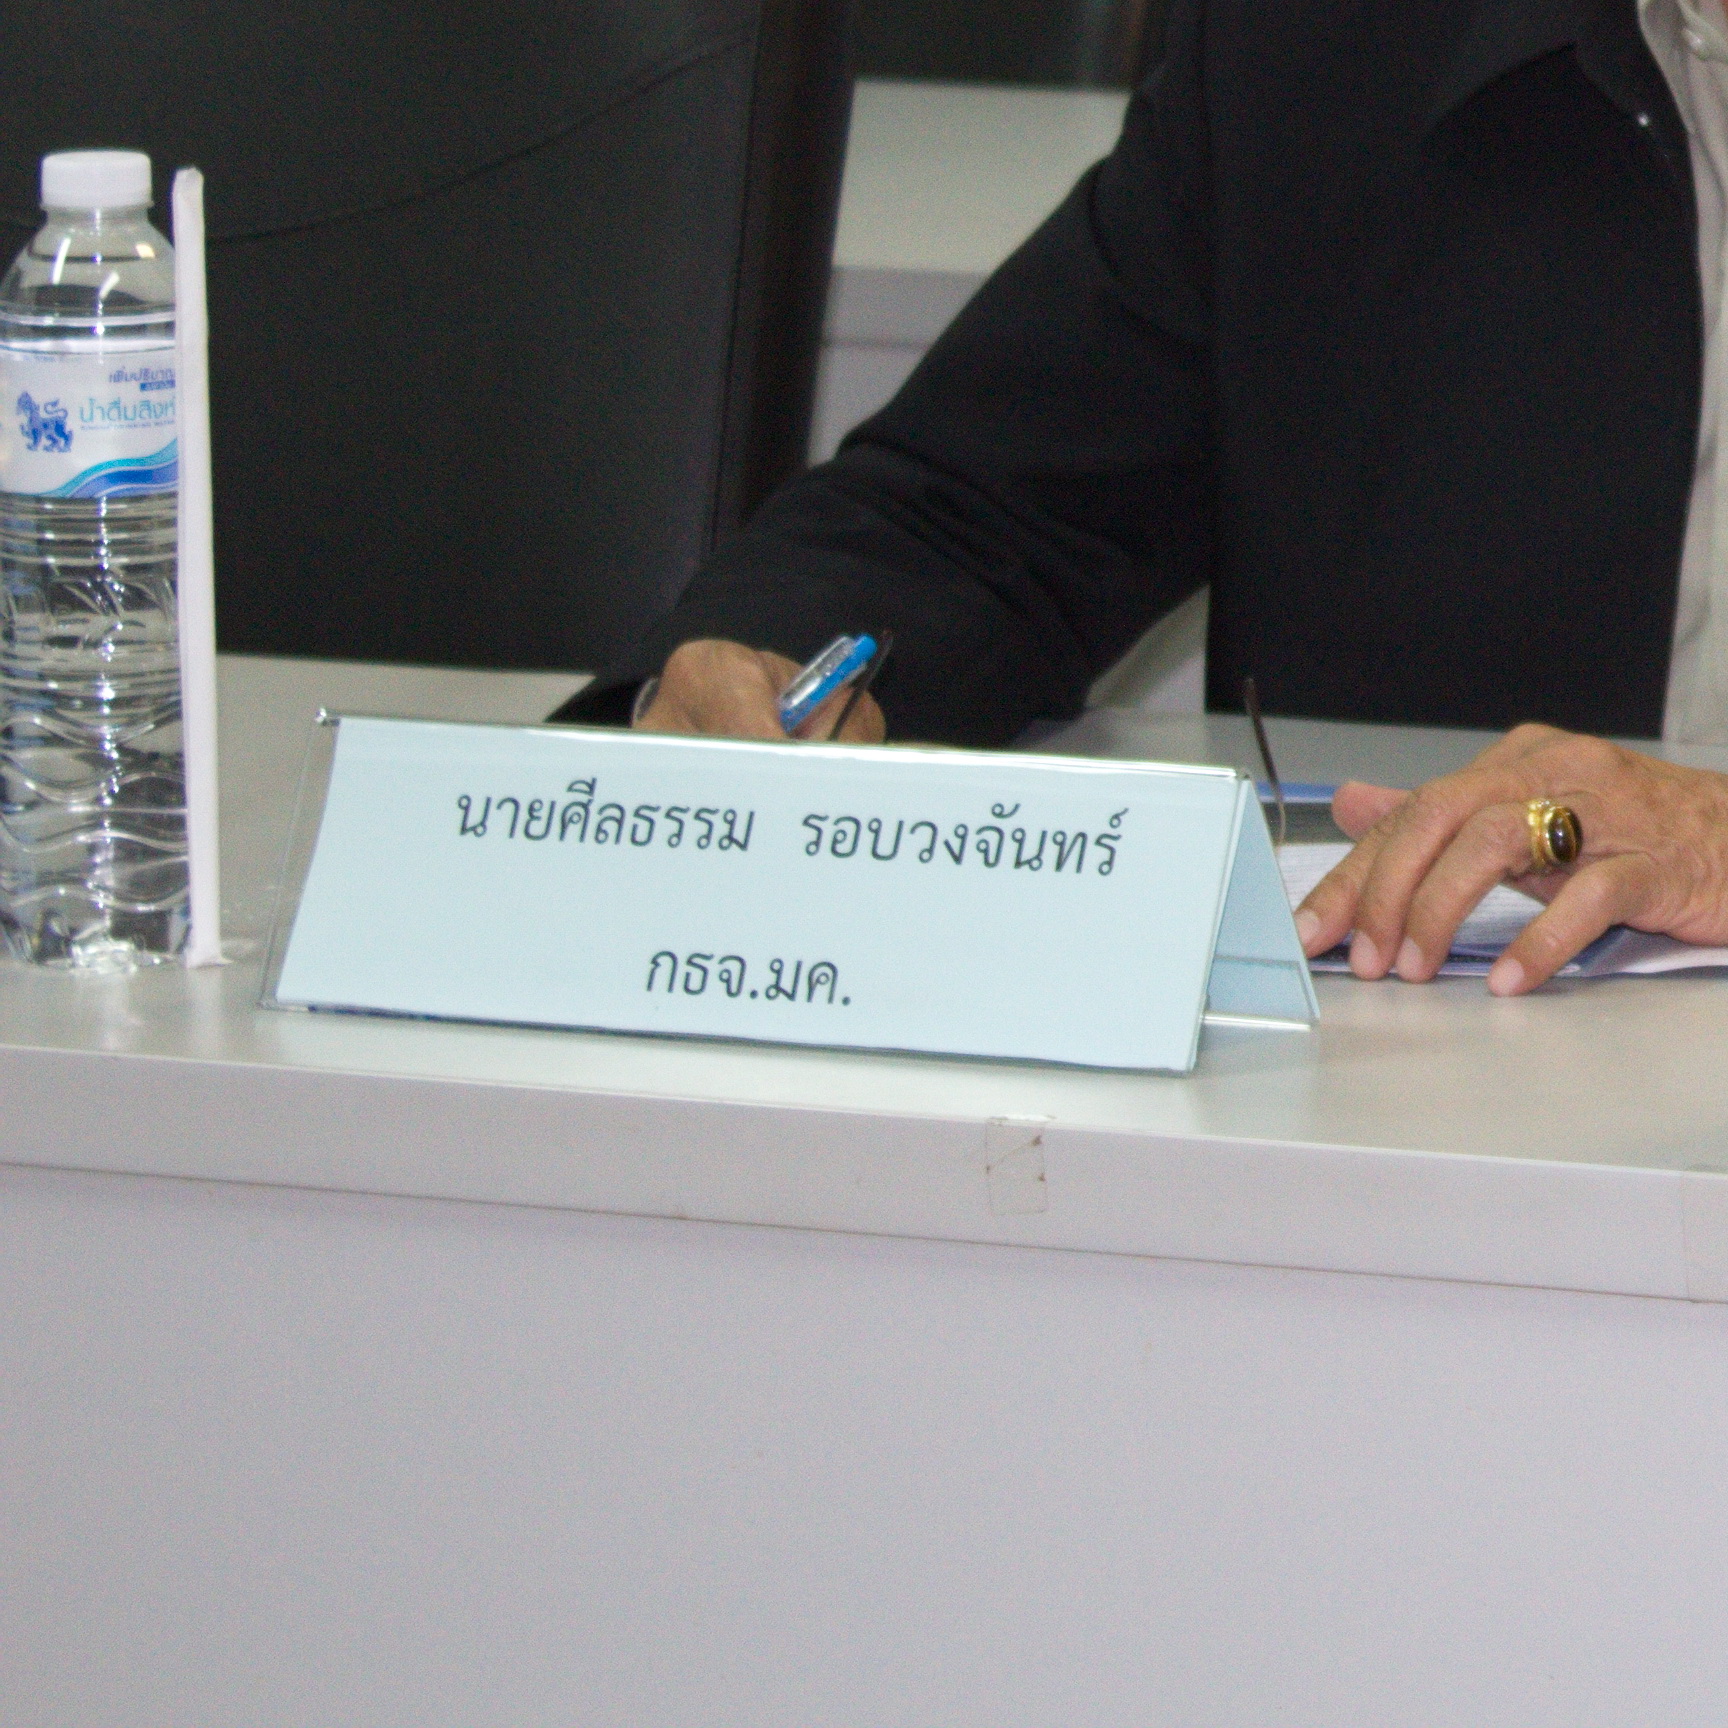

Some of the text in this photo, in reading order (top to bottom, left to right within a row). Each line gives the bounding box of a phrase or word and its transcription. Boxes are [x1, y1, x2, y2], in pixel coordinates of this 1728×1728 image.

[457, 778, 1129, 876] นายศีลธรรม รอบวงจันทร์
[646, 950, 851, 1005] กธจ.มค.
